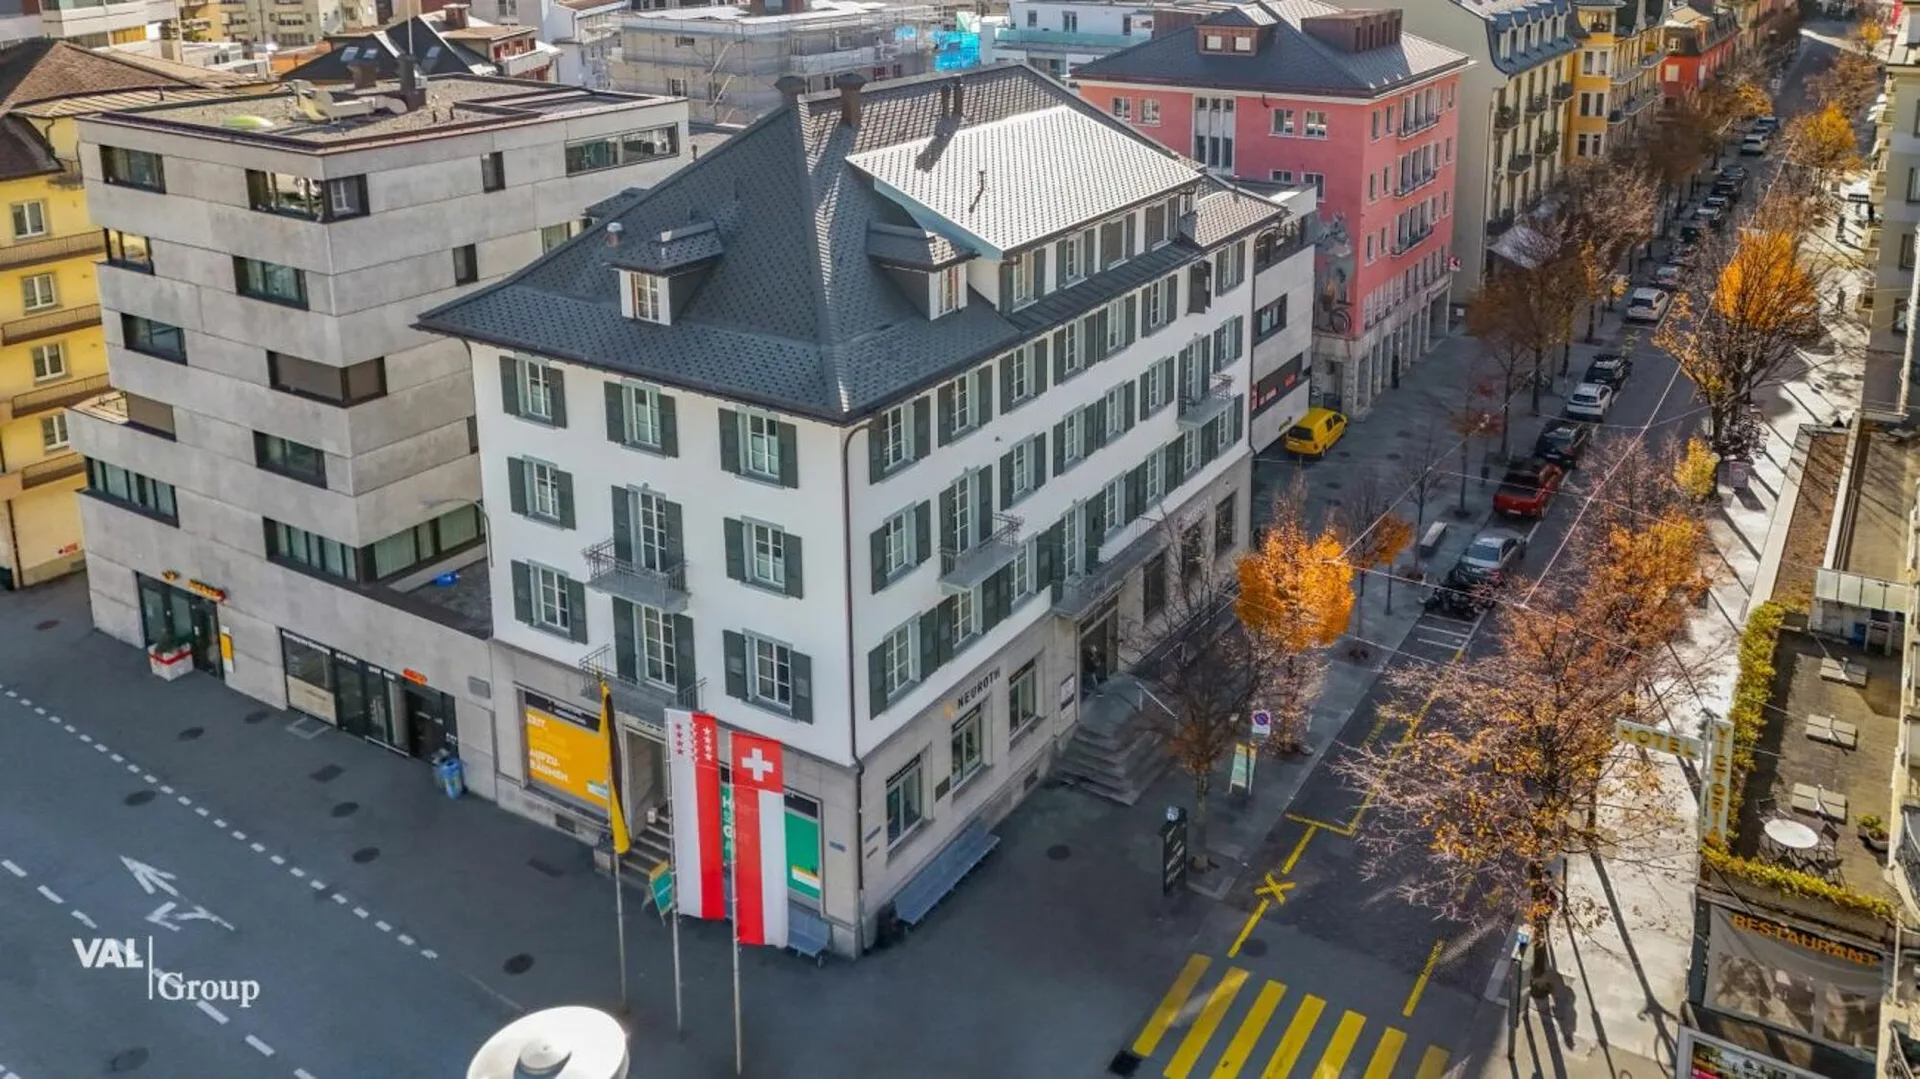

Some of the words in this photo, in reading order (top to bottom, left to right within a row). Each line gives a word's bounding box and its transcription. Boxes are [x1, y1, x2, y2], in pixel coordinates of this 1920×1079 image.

[958, 666, 1000, 709] NEUROTH
[1620, 726, 1697, 758] HOTEL
[1705, 727, 1731, 844] VICTORIA
[1732, 914, 1878, 966] RESTAURANT
